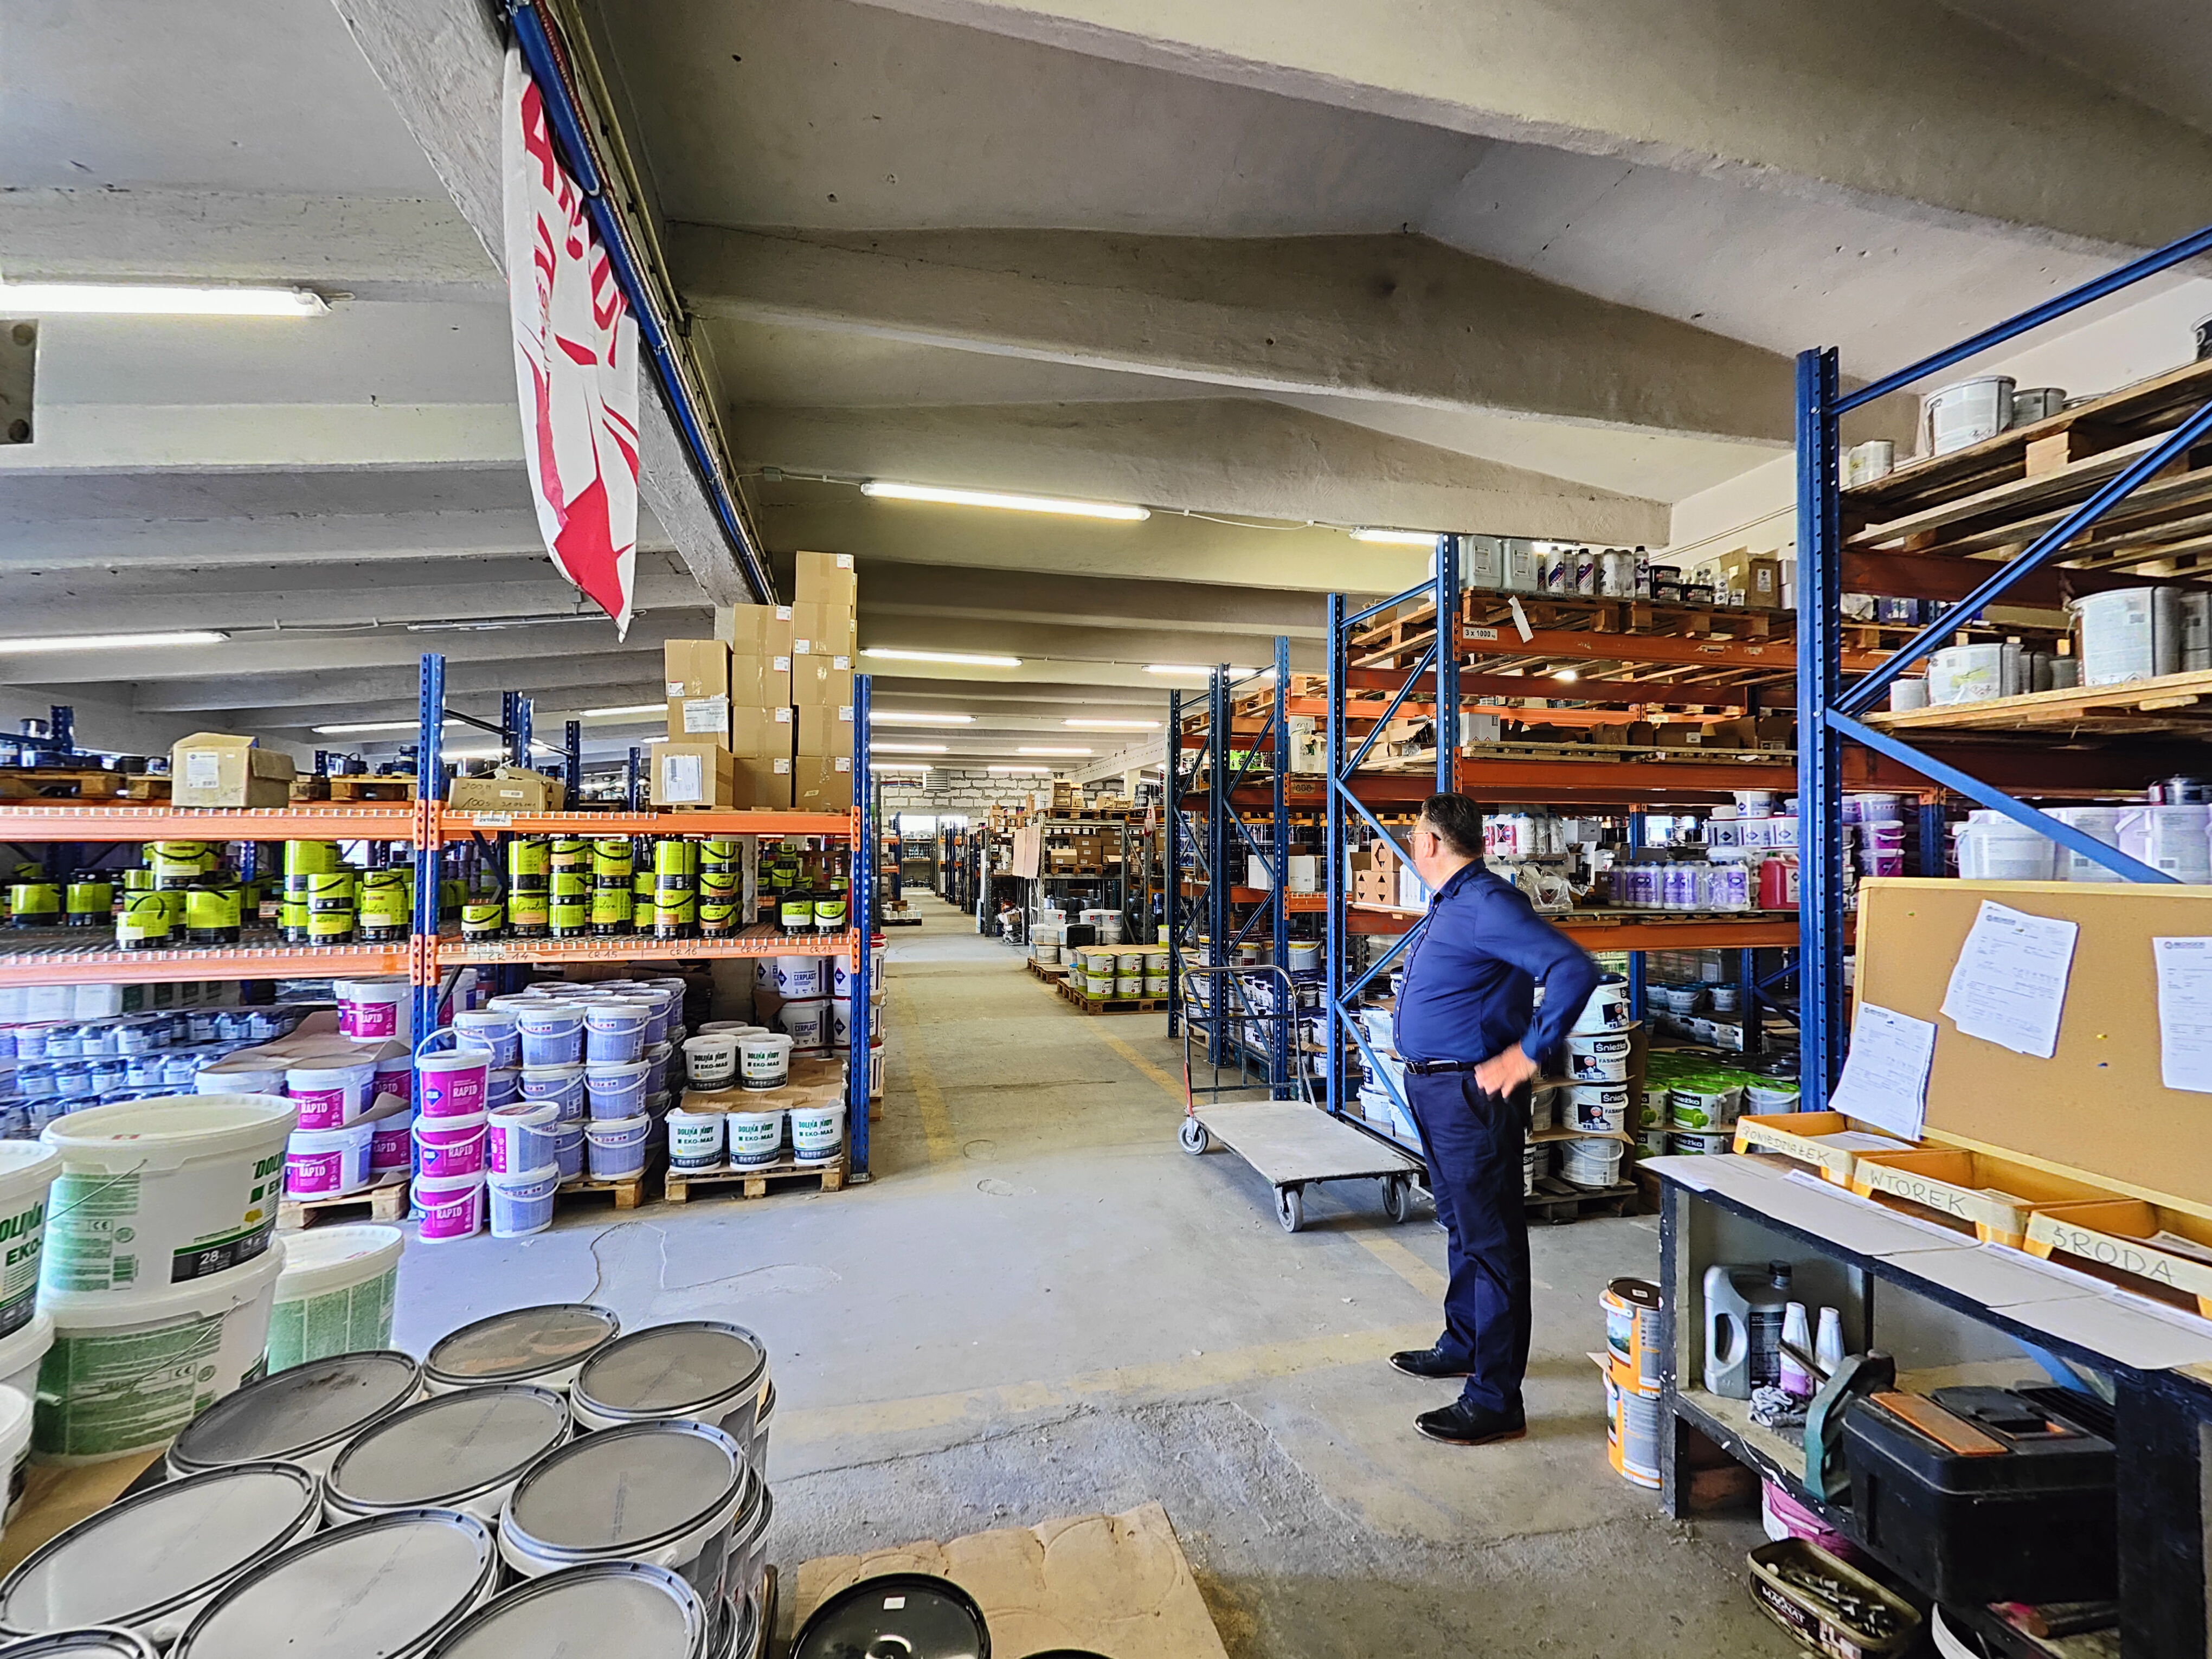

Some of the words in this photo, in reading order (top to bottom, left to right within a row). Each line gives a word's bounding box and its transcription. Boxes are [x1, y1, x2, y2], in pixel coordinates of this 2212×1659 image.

[794, 972, 817, 981] CERPLAST
[794, 1023, 818, 1032] CERPLAST
[453, 1084, 478, 1098] RAPID
[301, 1102, 328, 1114] RAPID
[744, 1133, 774, 1141] EKO-MAS
[805, 1128, 834, 1137] EKO-MAS
[683, 1136, 714, 1144] EKO-MAS
[448, 1144, 474, 1158] RAPID
[299, 1166, 326, 1178] RAPID
[1869, 1169, 1967, 1216] WTOREK
[436, 1206, 463, 1220] RAPID
[200, 1250, 220, 1265] 28
[1762, 1585, 1805, 1624] MAGNAT
